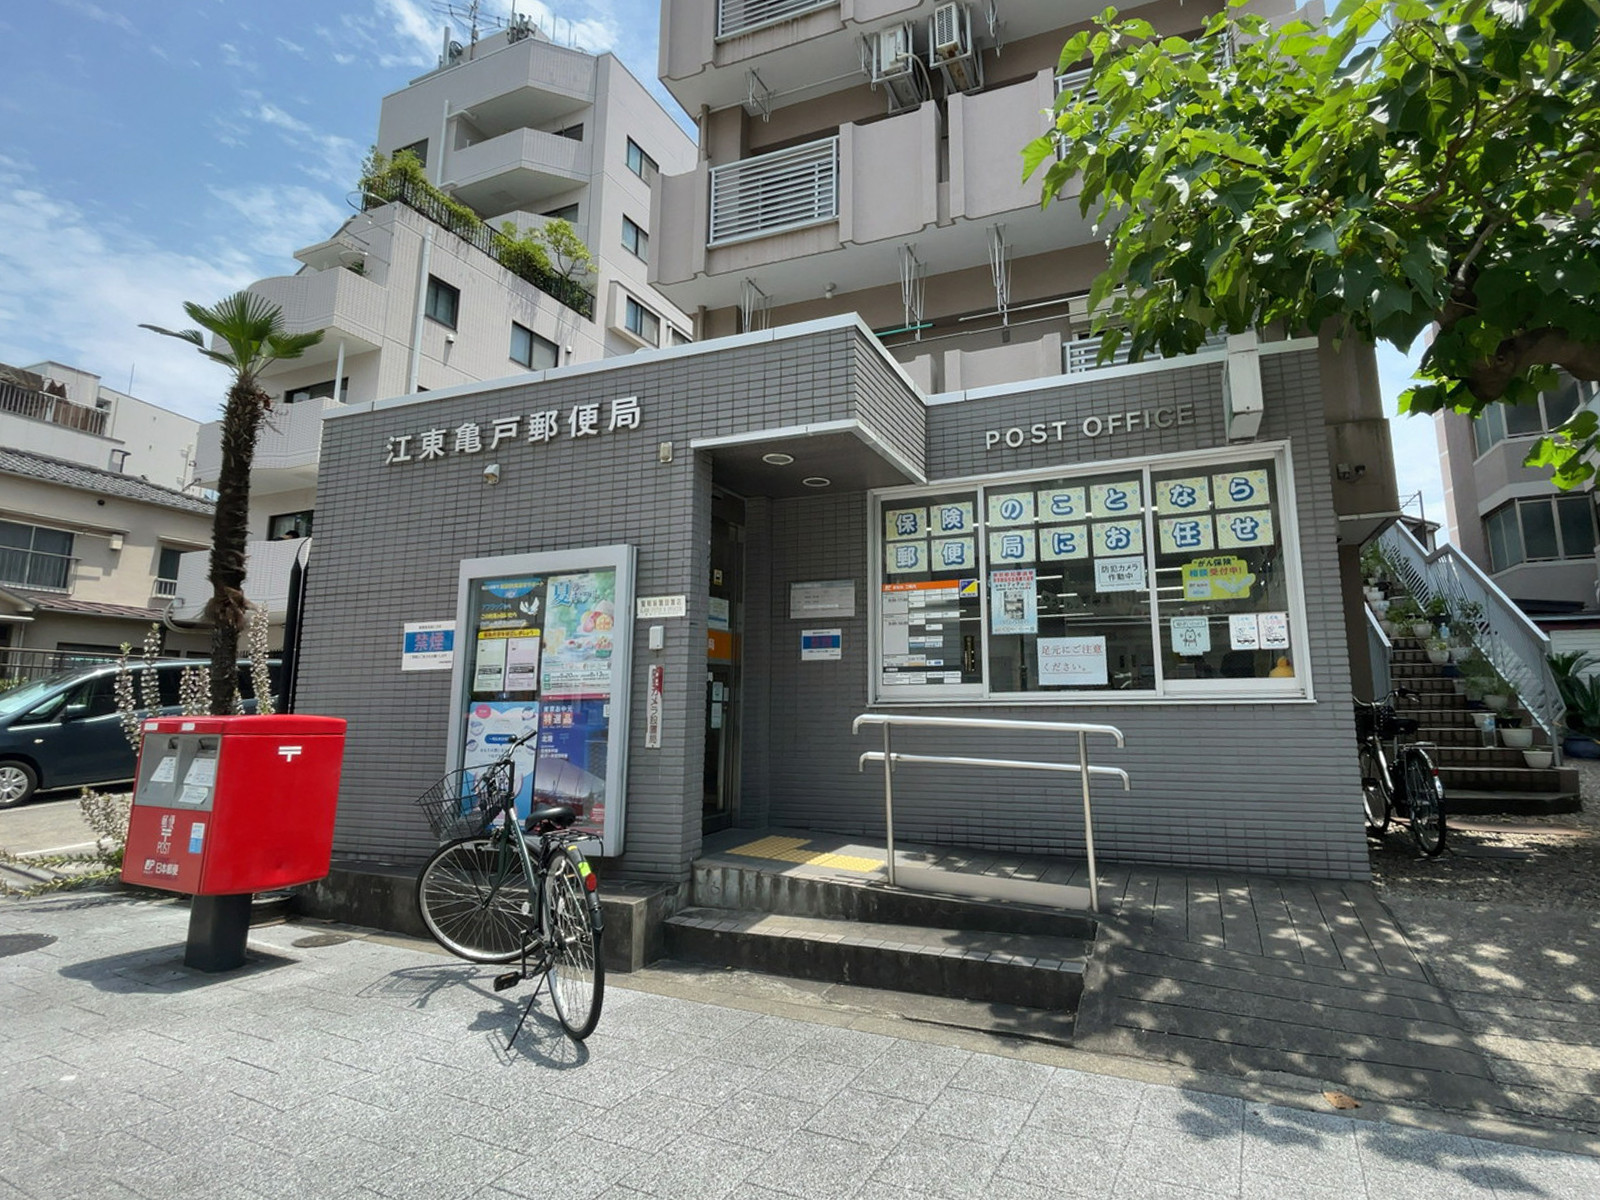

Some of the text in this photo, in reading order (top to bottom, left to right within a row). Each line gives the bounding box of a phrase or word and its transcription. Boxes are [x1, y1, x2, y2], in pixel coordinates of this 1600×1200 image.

[385, 396, 641, 465] 江東亀戸郵便局
[985, 403, 1194, 450] POST OFFICE
[896, 477, 1255, 536] 保険のことなら
[896, 516, 1259, 568] 郵便局にお任せ
[1101, 563, 1138, 574] 防犯カメラ
[1108, 572, 1134, 582] 作動中
[414, 632, 445, 652] 禁煙
[1041, 643, 1102, 656] 足元にご注意
[156, 842, 172, 854] POST
